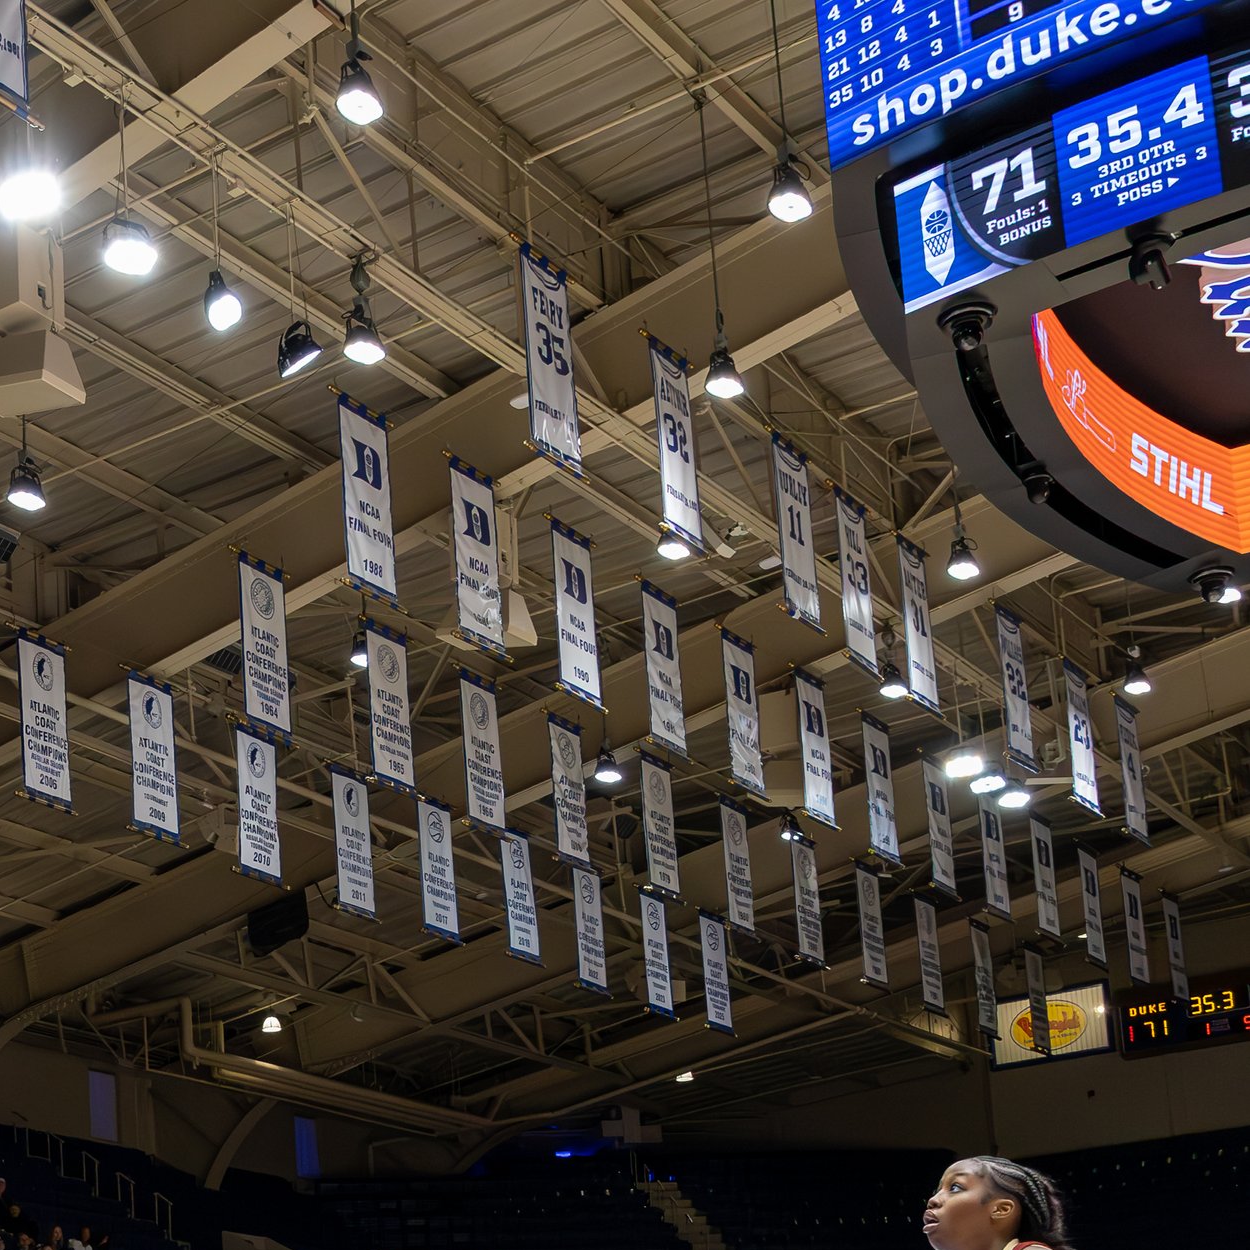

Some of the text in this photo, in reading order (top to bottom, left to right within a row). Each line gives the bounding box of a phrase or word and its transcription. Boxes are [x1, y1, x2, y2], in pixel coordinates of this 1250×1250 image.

[827, 4, 841, 21] 4
[1008, 1, 1023, 22] 9
[824, 29, 847, 53] 13
[860, 15, 873, 34] 8
[828, 10, 940, 81] 21 12 4 1
[829, 38, 944, 109] 35 10 4 3
[971, 82, 1205, 215] 71 35.4
[1098, 139, 1176, 179] 3RD QTR
[1071, 146, 1207, 207] 3 TIMEOUTS 3
[1117, 179, 1164, 207] POSS
[986, 199, 1049, 235] Fouls: 1
[999, 215, 1052, 246] BONUS
[531, 286, 563, 330] FERY
[535, 321, 570, 376] 35
[663, 412, 690, 464] 32
[1130, 432, 1224, 515] STIHL
[359, 500, 381, 522] NCAA
[348, 517, 372, 539] FINAL
[787, 504, 805, 547] 11
[363, 558, 383, 578] 1988
[469, 556, 490, 576] NCAA
[569, 613, 586, 633] NCAA
[250, 626, 280, 649] ATLANTIC
[561, 628, 580, 649] FINAL
[255, 641, 277, 661] COAST
[245, 650, 288, 680] CONFERENCE
[248, 665, 287, 693] CHAMPIONS
[1005, 661, 1028, 702] 22
[29, 700, 61, 721] ATLANTIC
[260, 701, 279, 719] 1964
[377, 688, 404, 709] ATLANTIC
[382, 703, 401, 719] COAST
[34, 715, 57, 732] COAST
[373, 712, 412, 738] CONFERENCE
[25, 724, 69, 751] CONFERENCE
[138, 737, 169, 757] ATLANTIC
[27, 739, 68, 764] CHAMPIONS
[145, 752, 166, 767] COAST
[134, 761, 175, 786] CONFERENCE
[470, 771, 502, 793] CHAMPIONS
[136, 775, 175, 798] CHAMPIONS
[149, 807, 166, 823] 2009
[253, 852, 271, 867] 2010
[1129, 990, 1234, 1018] DUKE 35.3
[1143, 1019, 1169, 1039] 71
